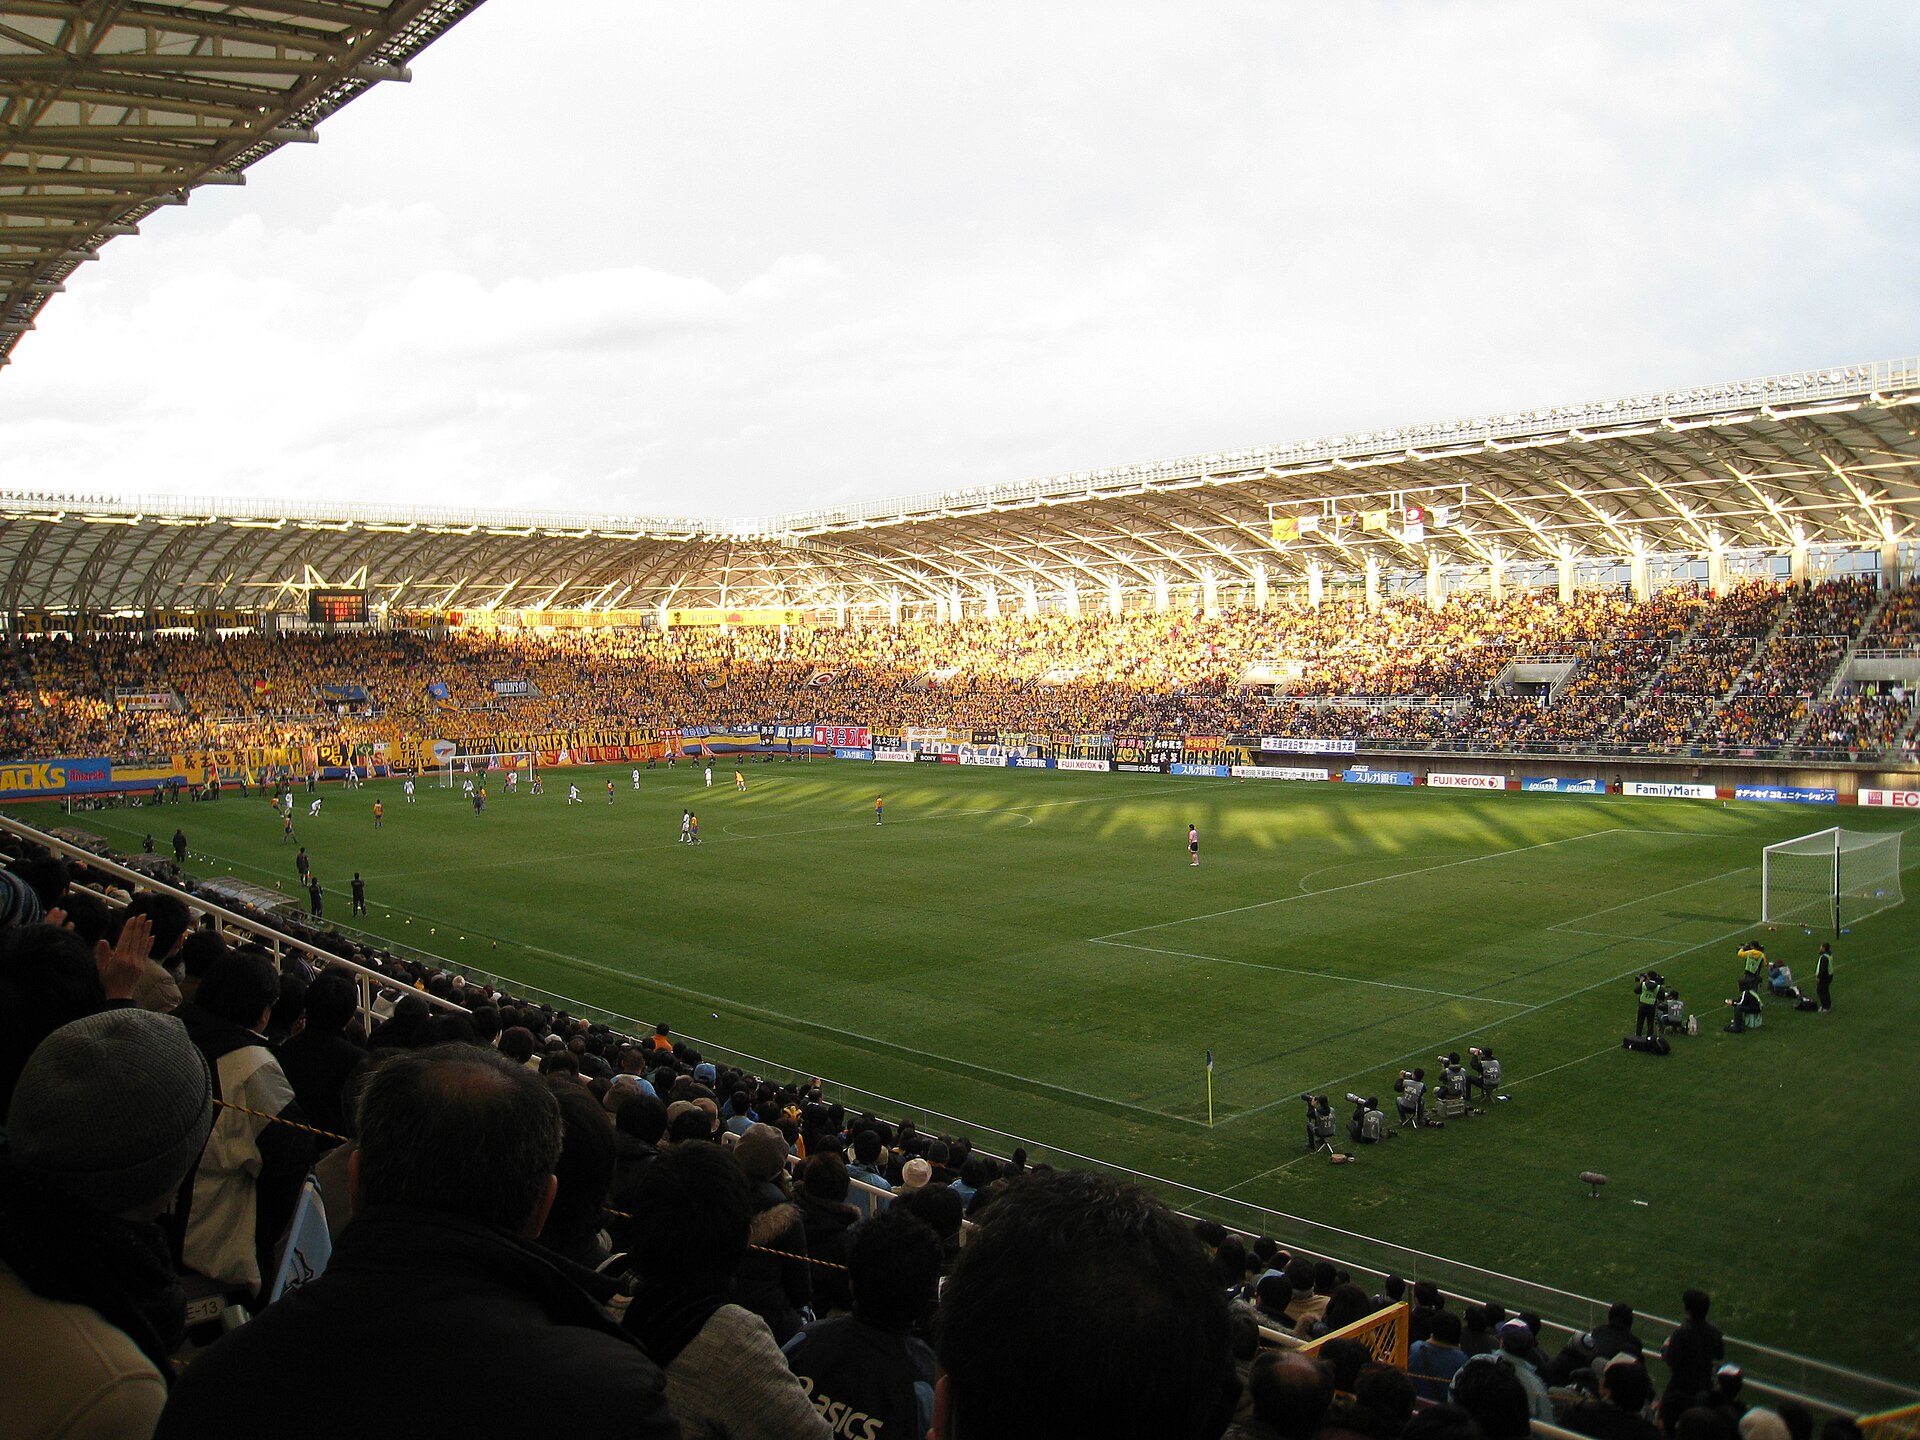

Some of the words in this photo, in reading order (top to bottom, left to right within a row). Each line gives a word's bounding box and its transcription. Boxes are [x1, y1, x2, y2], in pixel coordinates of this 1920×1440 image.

[400, 741, 422, 750] GET
[1061, 760, 1075, 768] FUJI
[1139, 764, 1160, 772] adidas
[1181, 765, 1217, 776] スルガ銀行
[1355, 772, 1398, 784] スルガ銀行
[1433, 776, 1453, 785] FUJI
[1636, 784, 1701, 797] FamilyMart
[1735, 788, 1769, 798] オデッセイ
[1770, 791, 1835, 801] コミュニケーションズ
